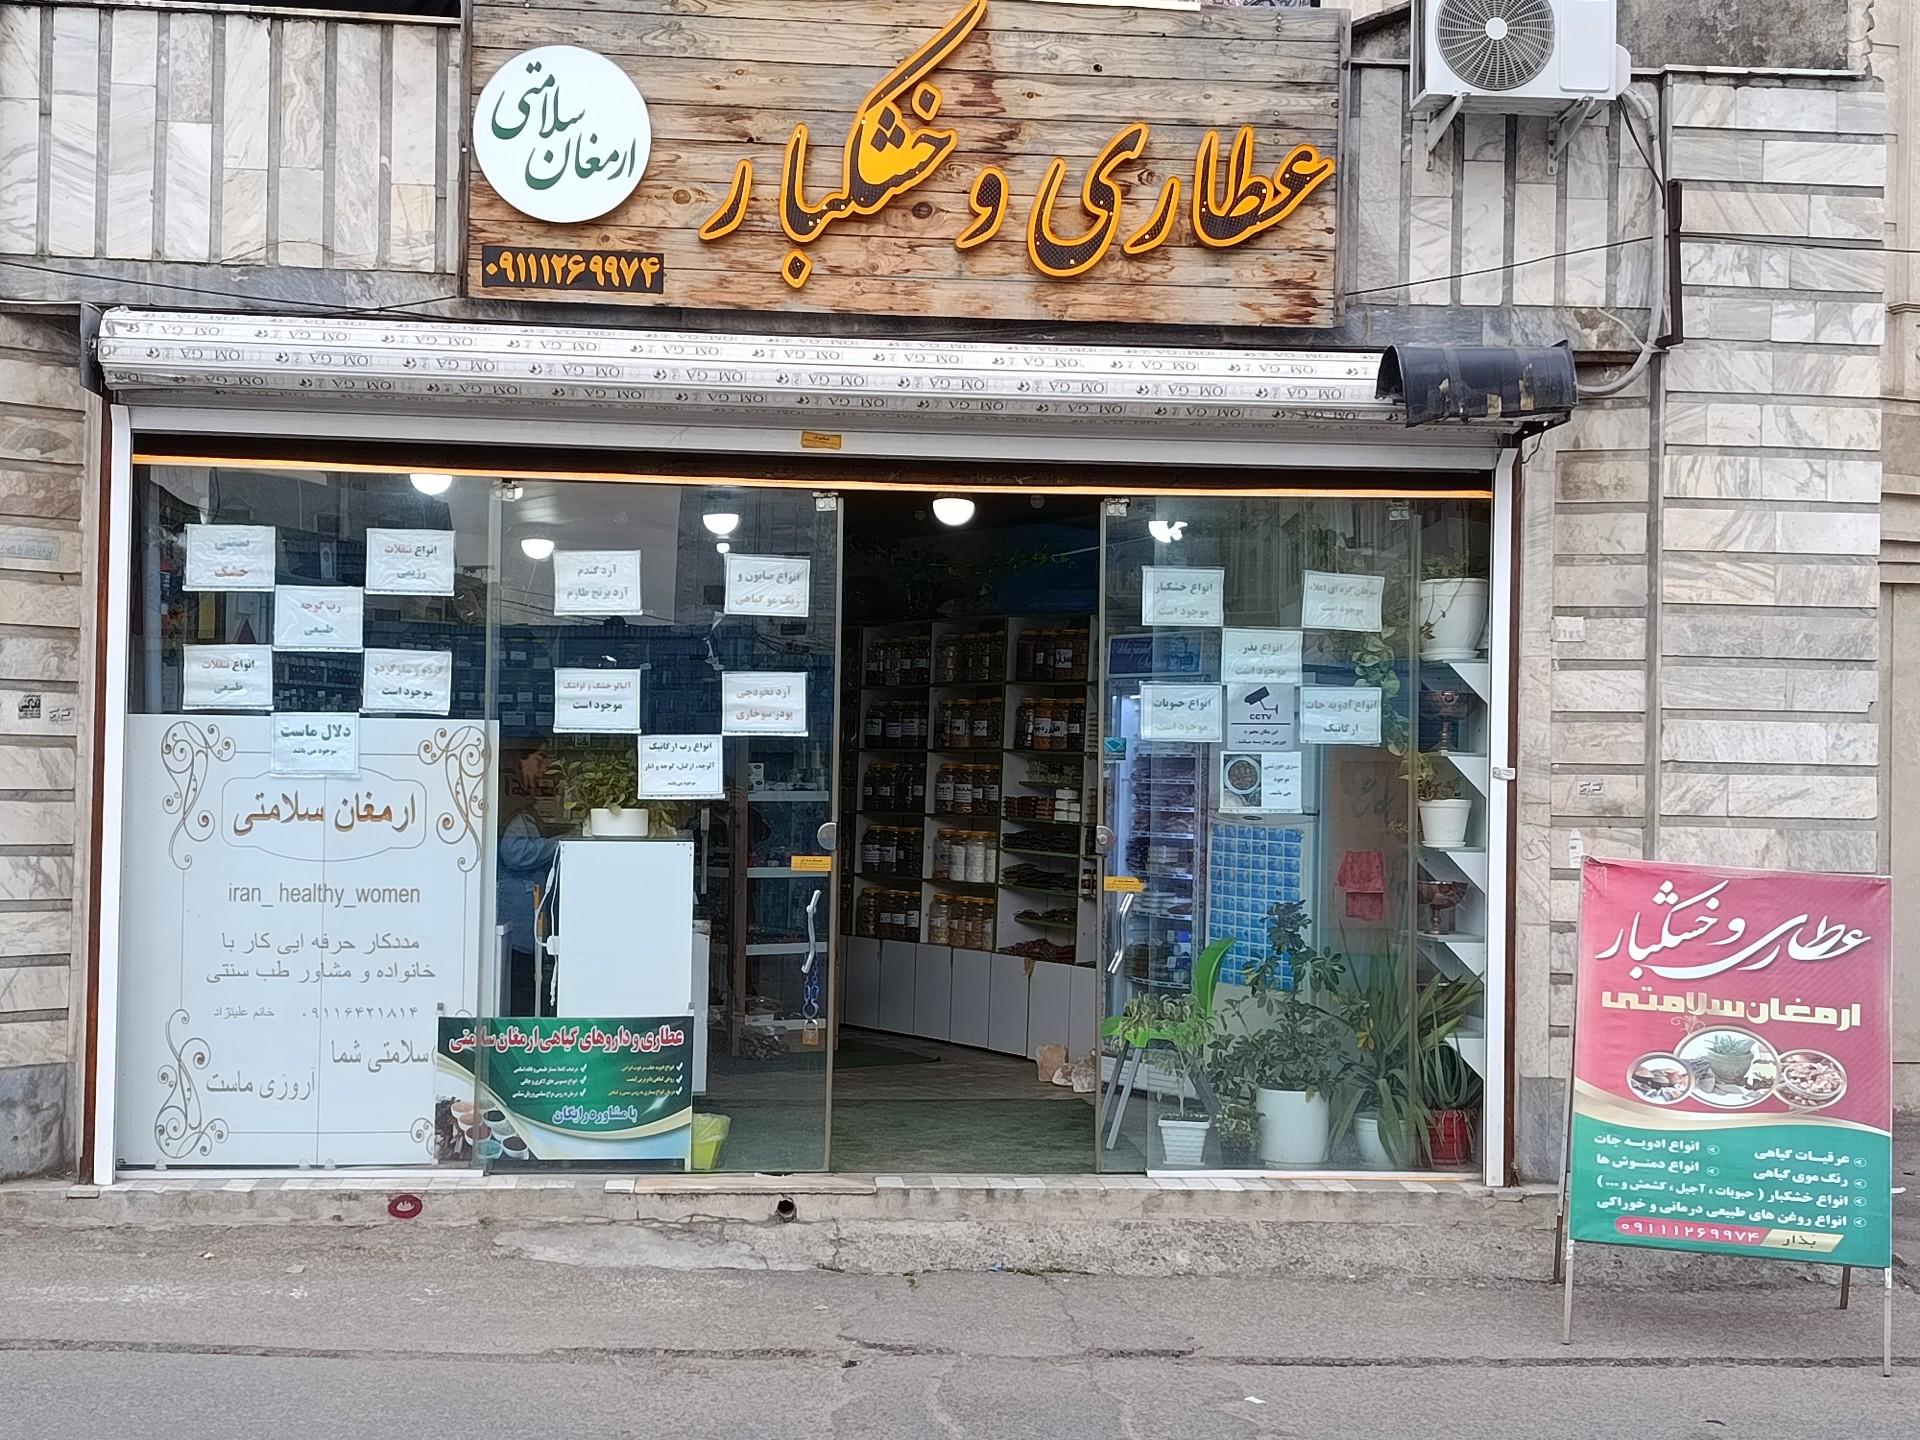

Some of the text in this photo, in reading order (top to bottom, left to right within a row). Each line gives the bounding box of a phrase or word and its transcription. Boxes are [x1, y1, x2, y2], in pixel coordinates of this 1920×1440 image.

[490, 60, 587, 140] سلامتی
[698, 0, 1336, 290] عطاری و خشکبار
[523, 131, 637, 191] ارمغان
[414, 544, 437, 557] انواع
[775, 571, 801, 585] انواع
[1155, 581, 1213, 596] انواع خشکبار
[231, 659, 255, 672] انواع
[381, 686, 433, 699] موجود است
[572, 700, 623, 713] موجود است
[1187, 698, 1212, 711] انواع
[1353, 699, 1377, 713] انواع
[280, 723, 351, 741] دلال ماست
[692, 741, 713, 753] انواع
[232, 790, 417, 836] ارمغان سلامتی
[1593, 879, 1872, 981] عطاری و خشکبار
[220, 932, 420, 955] مددکار حرفه ایی کار با
[206, 960, 436, 984] خانواده و مشاور طب سنتی
[213, 1005, 418, 1021] ۰۹۱۱۶۴۲۱۸۱۴ خانم علینژاد
[1601, 985, 1862, 1032] ارمغان سلامتی
[495, 1026, 539, 1054] ارمغان
[537, 1026, 580, 1054] گیاهی
[578, 1025, 631, 1053] داروهای
[631, 1033, 641, 1053] و
[640, 1025, 685, 1053] عطاری
[330, 1038, 429, 1074] سلامتی شما
[205, 1070, 254, 1094] ماست
[1593, 1133, 1701, 1154] انواع ادویه جات
[1595, 1153, 1700, 1174] انواع دمنوش ها
[1753, 1147, 1850, 1167] عرقیات گیاهی
[1620, 1181, 1628, 1190] و
[1629, 1179, 1668, 1191] کشمش
[1752, 1167, 1849, 1188] رنگ موی گیاهی
[1766, 1189, 1814, 1204] خشکبار
[1815, 1194, 1849, 1209] انواع
[1596, 1195, 1848, 1229] انواع روغن های طبیعی درمانی و خوراکی
